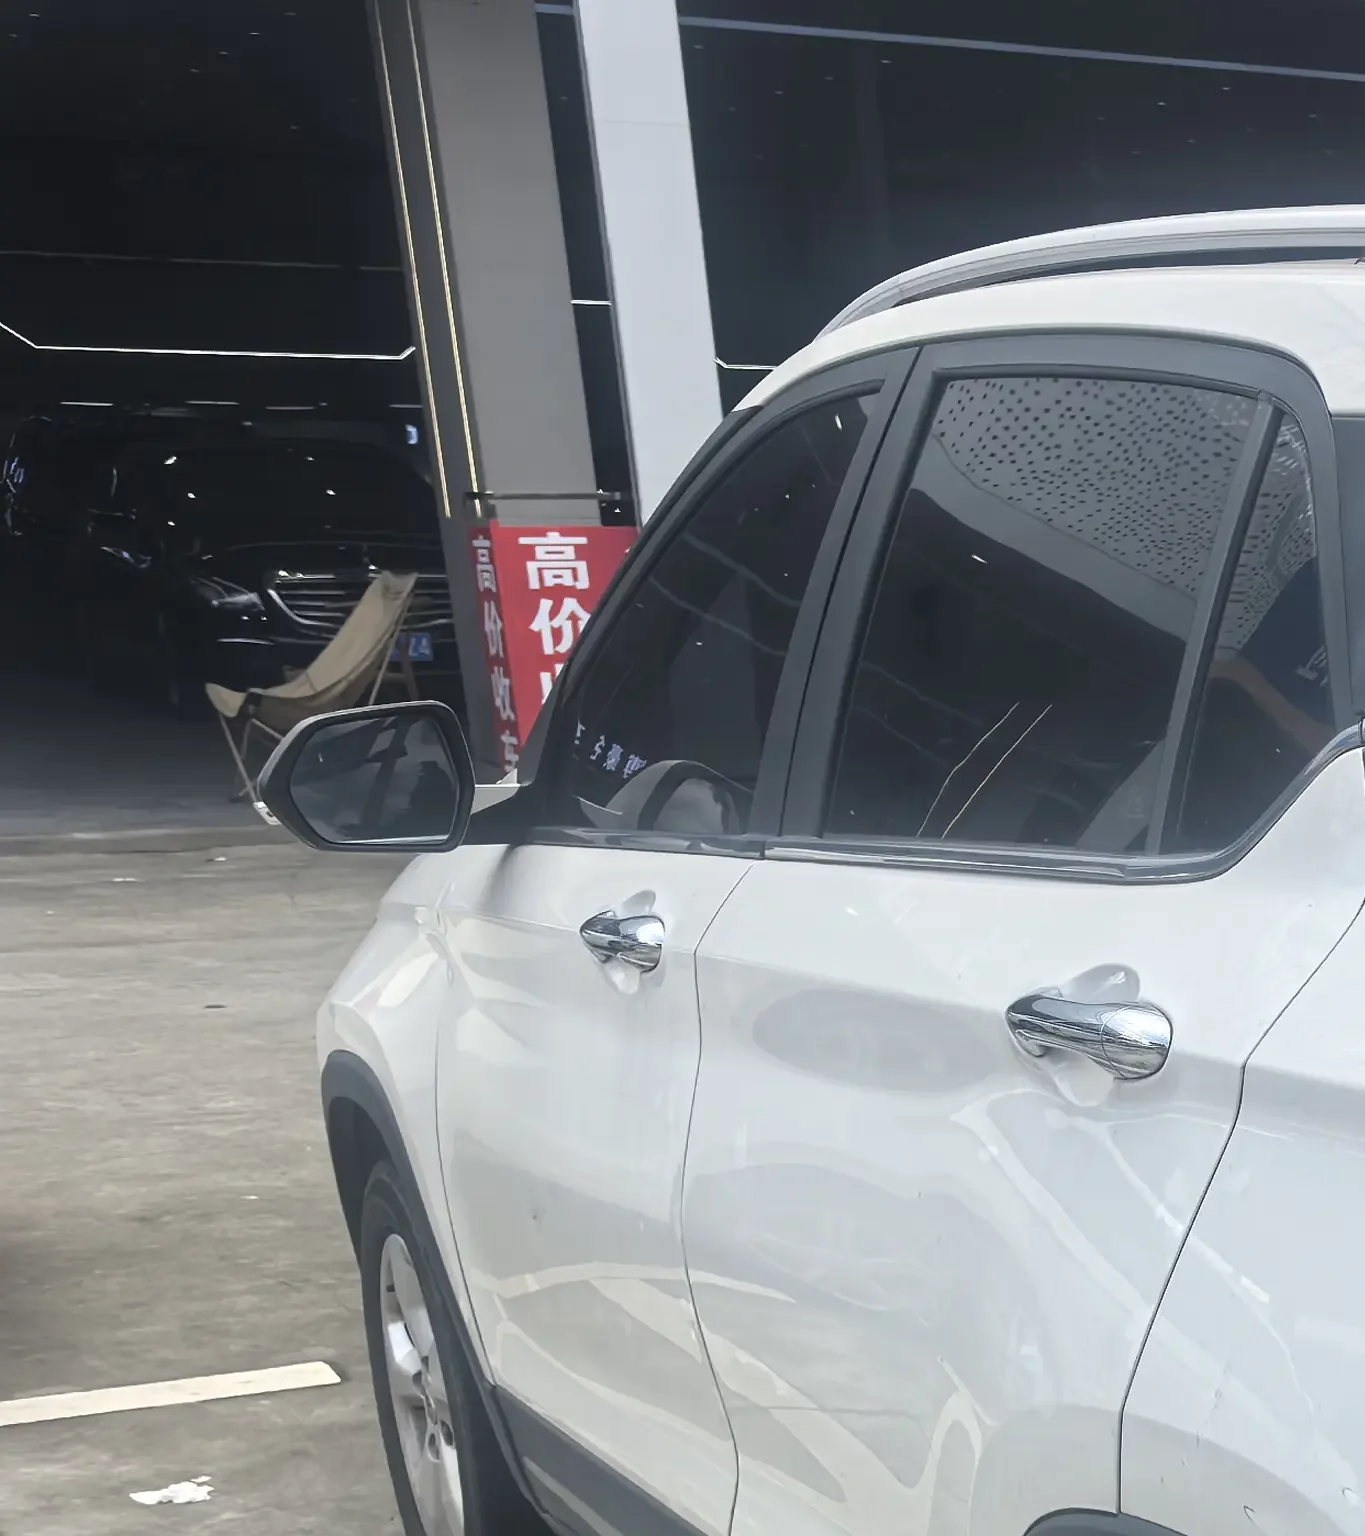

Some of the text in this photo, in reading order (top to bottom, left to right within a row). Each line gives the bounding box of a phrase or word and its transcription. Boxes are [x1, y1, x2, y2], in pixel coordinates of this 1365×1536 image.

[472, 535, 519, 773] 高价收车
[518, 531, 592, 704] 高价
